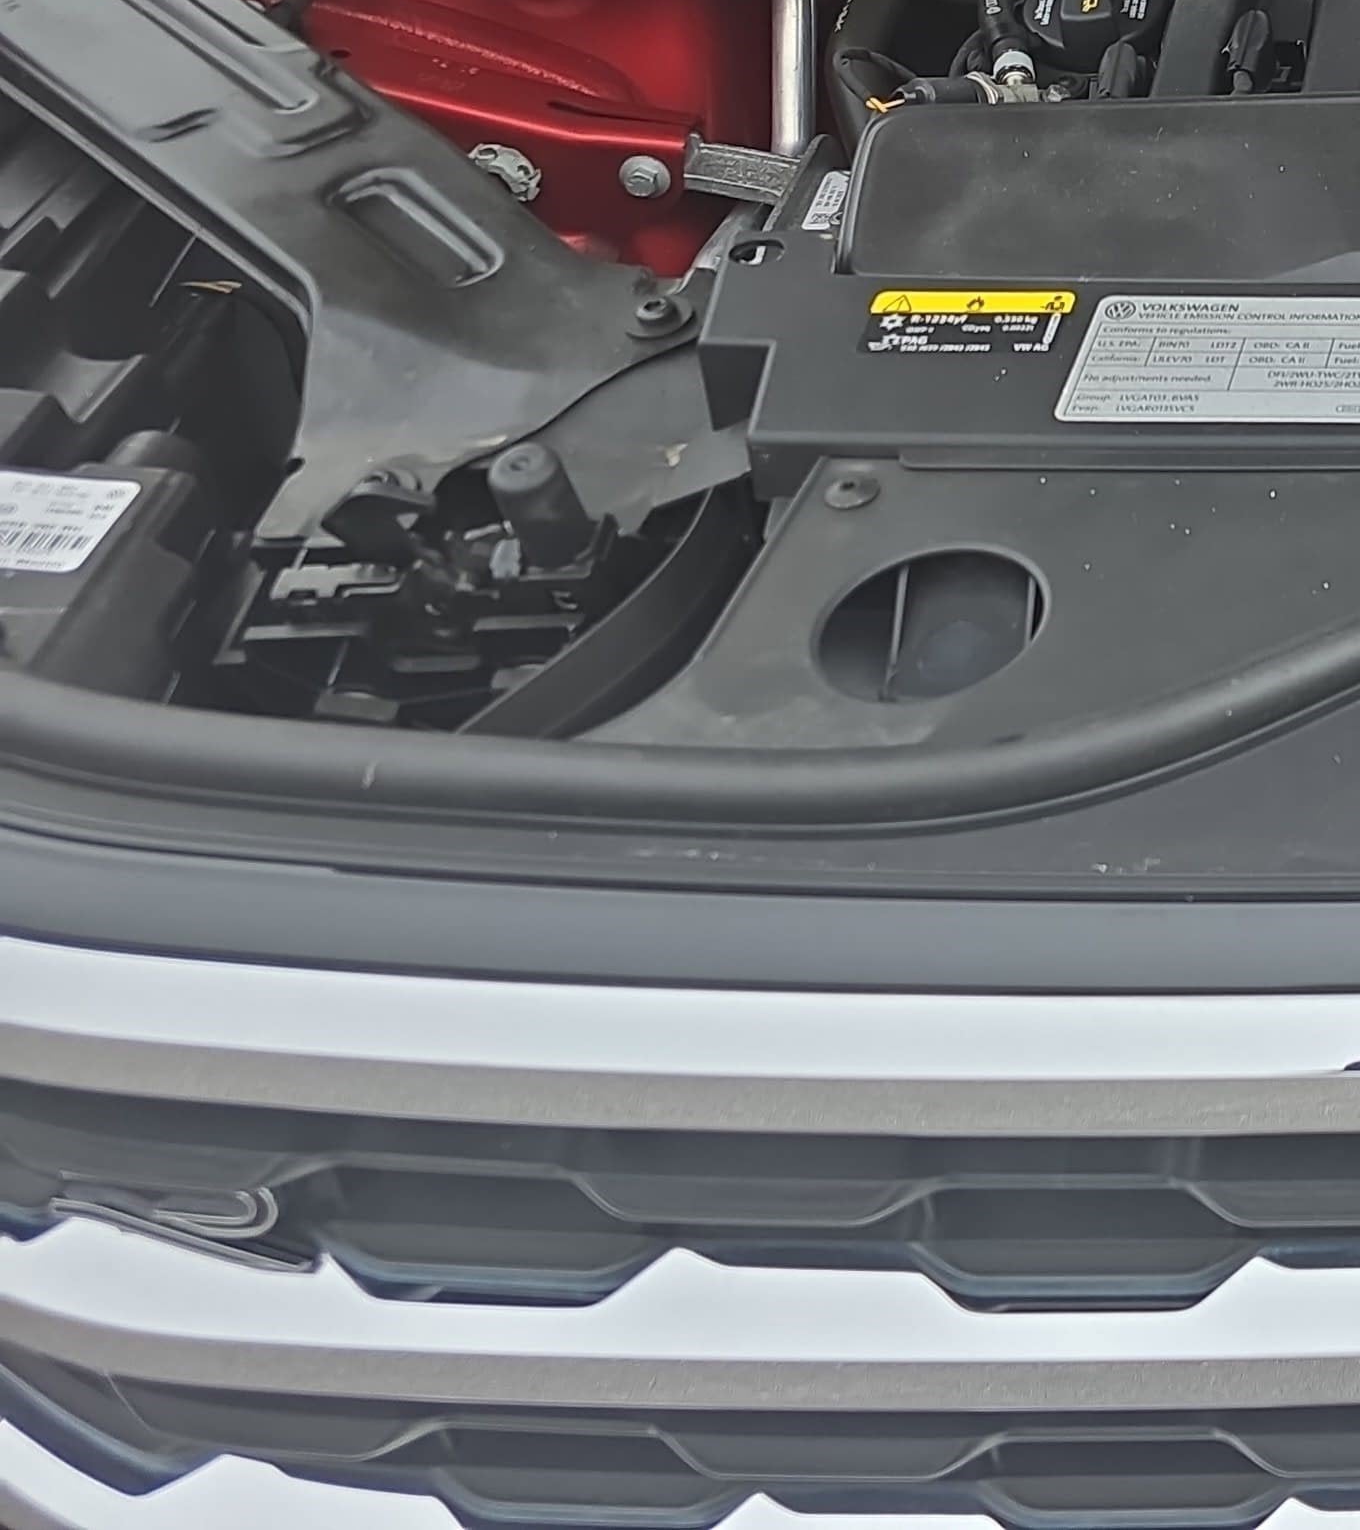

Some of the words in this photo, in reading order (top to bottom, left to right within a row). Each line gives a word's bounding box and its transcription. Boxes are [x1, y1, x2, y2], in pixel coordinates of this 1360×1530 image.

[1142, 302, 1240, 312] VOLKSWAGEN
[1182, 312, 1235, 320] EMISSION
[1103, 326, 1154, 334] Conforms
[1156, 326, 1168, 334] to
[1083, 374, 1100, 382] No
[1101, 374, 1168, 384] adjustments
